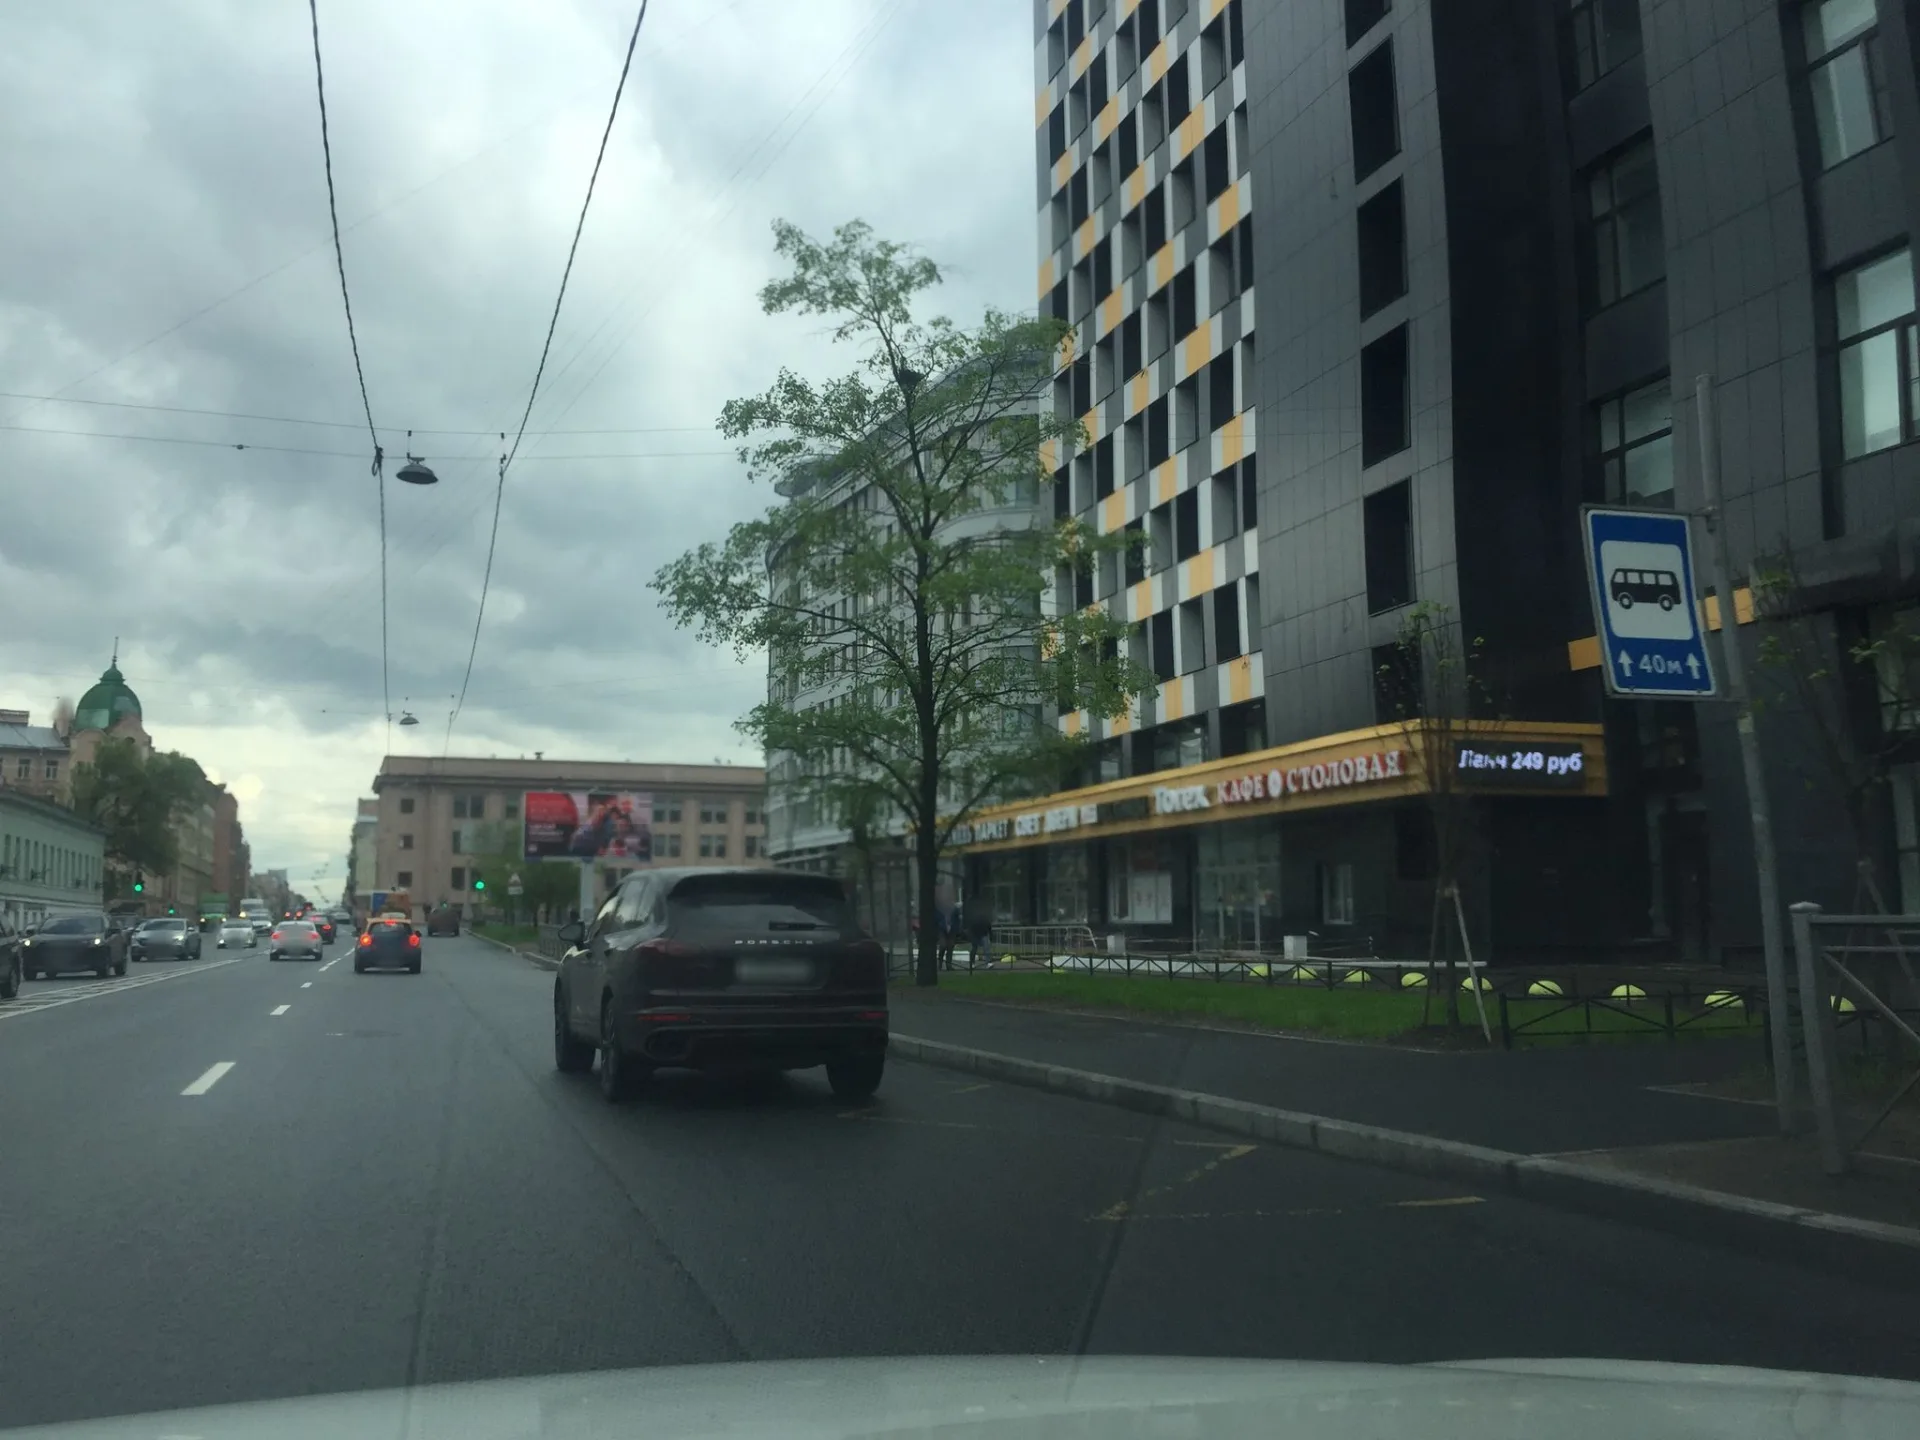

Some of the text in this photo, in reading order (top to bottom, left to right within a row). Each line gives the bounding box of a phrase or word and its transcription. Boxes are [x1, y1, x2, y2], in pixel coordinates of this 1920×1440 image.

[1217, 750, 1401, 804] КАФЕ СТОЛОВАЯ
[1511, 751, 1544, 770] 249
[1547, 752, 1582, 775] руб
